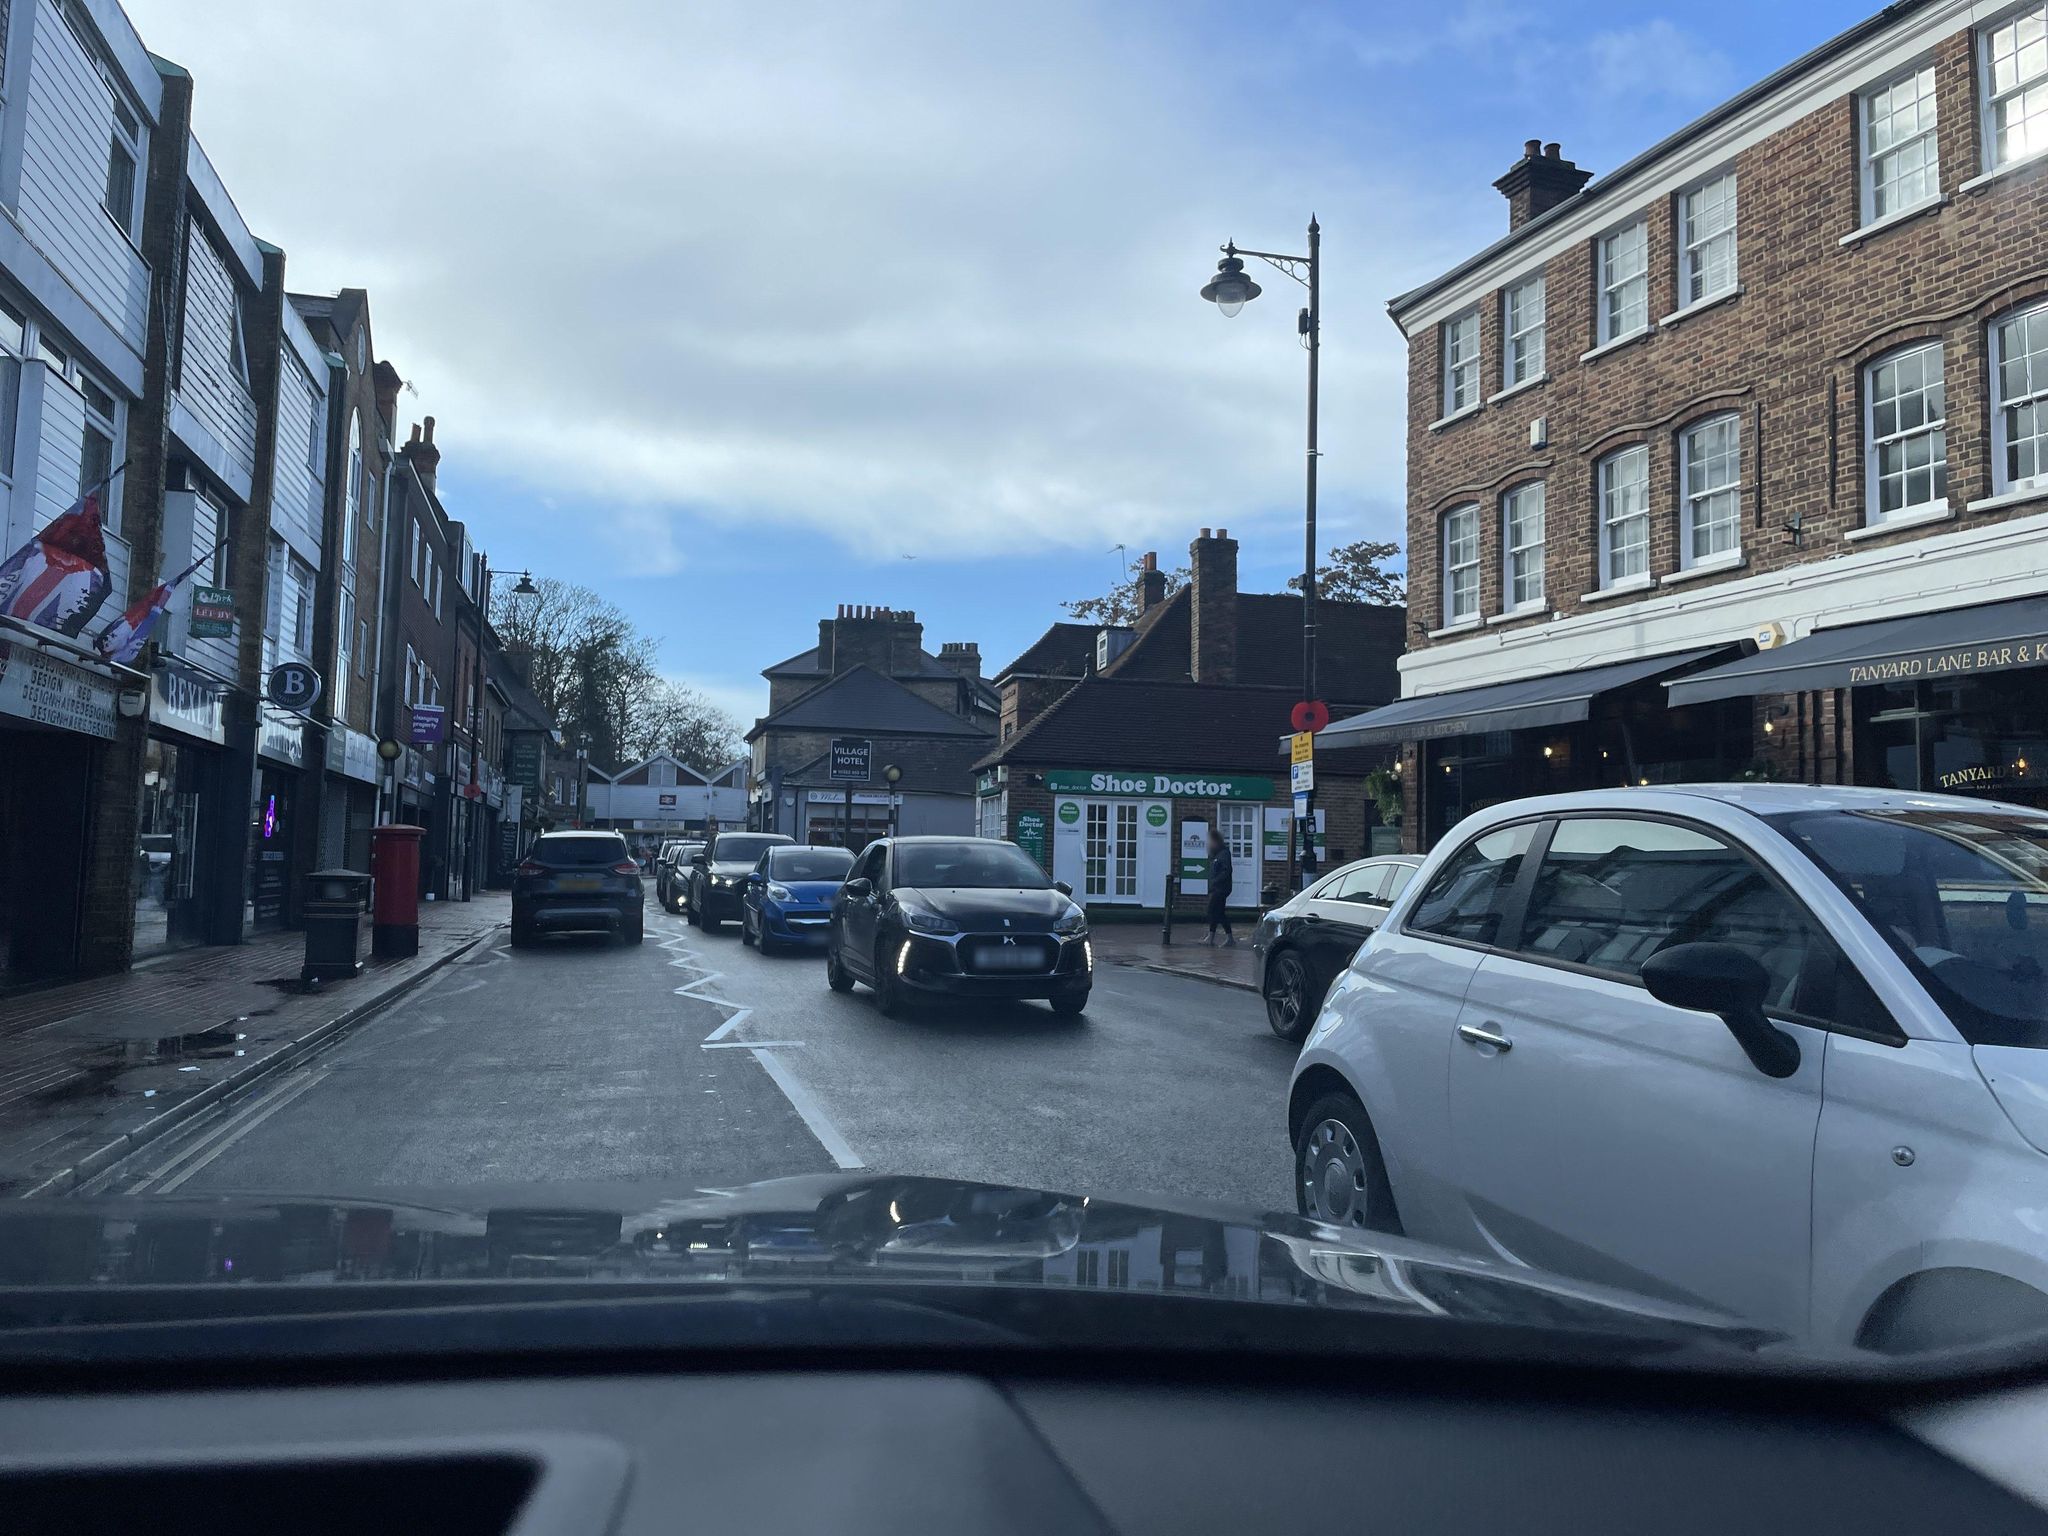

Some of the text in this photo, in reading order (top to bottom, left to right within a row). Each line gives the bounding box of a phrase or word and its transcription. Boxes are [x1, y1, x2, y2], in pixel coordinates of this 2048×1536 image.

[1850, 660, 1922, 682] TANYARD
[1927, 652, 1972, 673] LANE
[1976, 648, 2012, 668] BAR
[2017, 645, 2030, 662] &
[283, 670, 305, 696] B
[167, 672, 224, 732] BEXLEY
[833, 747, 869, 756] VILLAGE
[837, 757, 865, 766] HOTEL
[1090, 773, 1232, 796] Shoe Doctor
[1939, 765, 2006, 788] TANYARD
[1018, 820, 1044, 829] Doctor
[1022, 815, 1041, 823] Shoe
